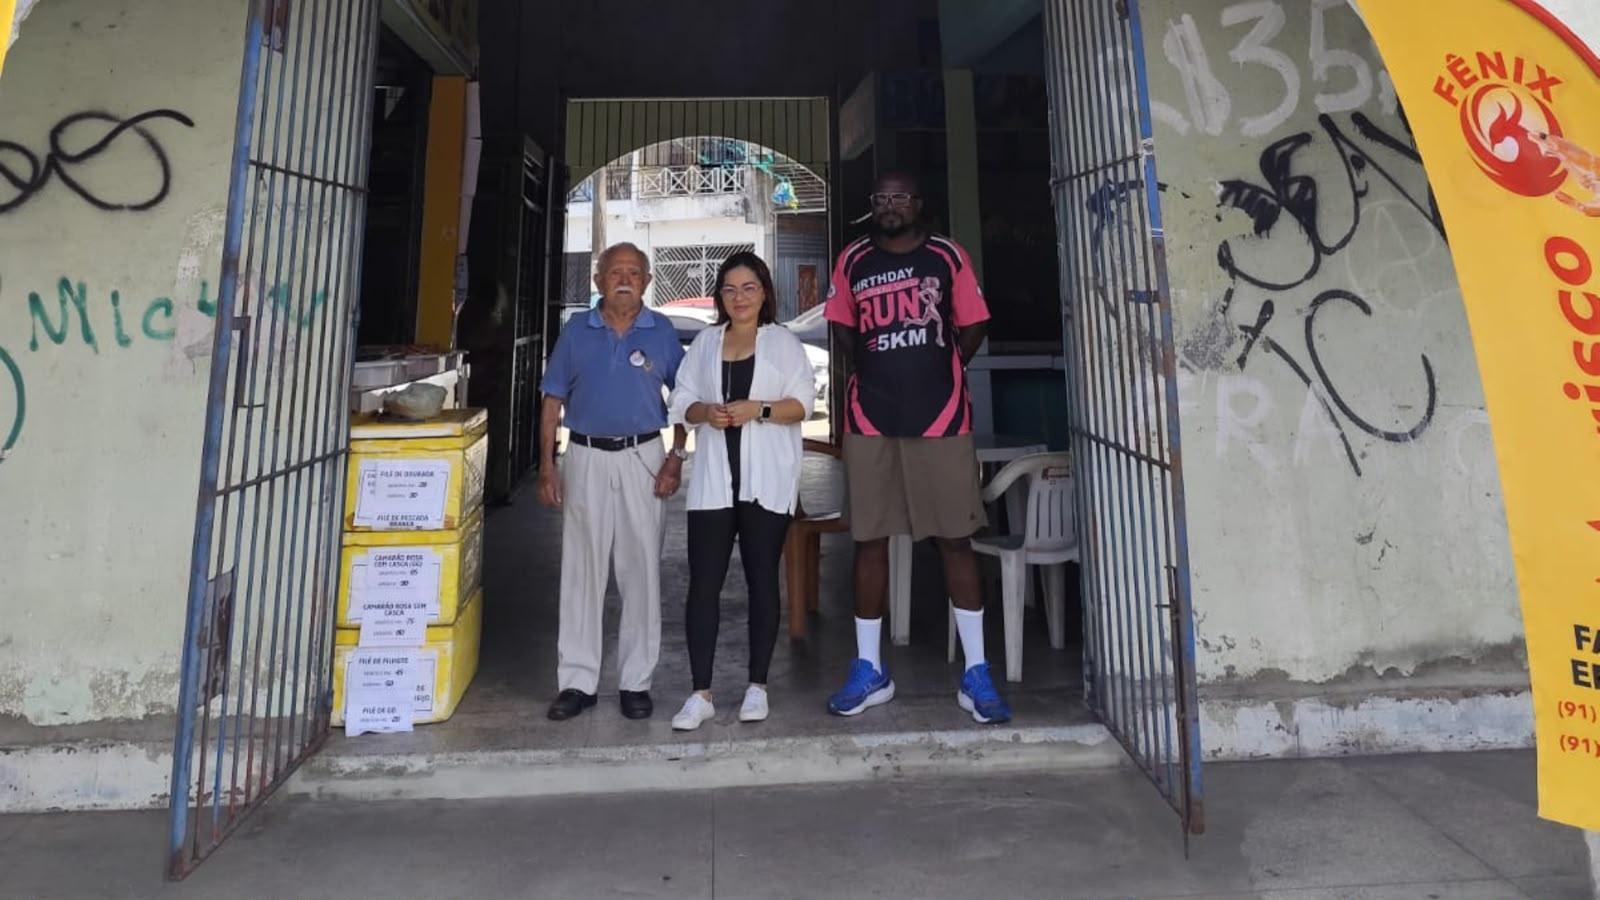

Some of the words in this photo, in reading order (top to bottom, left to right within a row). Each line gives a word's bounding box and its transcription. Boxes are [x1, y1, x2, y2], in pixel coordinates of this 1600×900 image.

[1432, 51, 1563, 107] FÊNIX
[859, 286, 921, 333] RUN
[877, 328, 928, 351] 5KM
[1558, 700, 1597, 723] (91)
